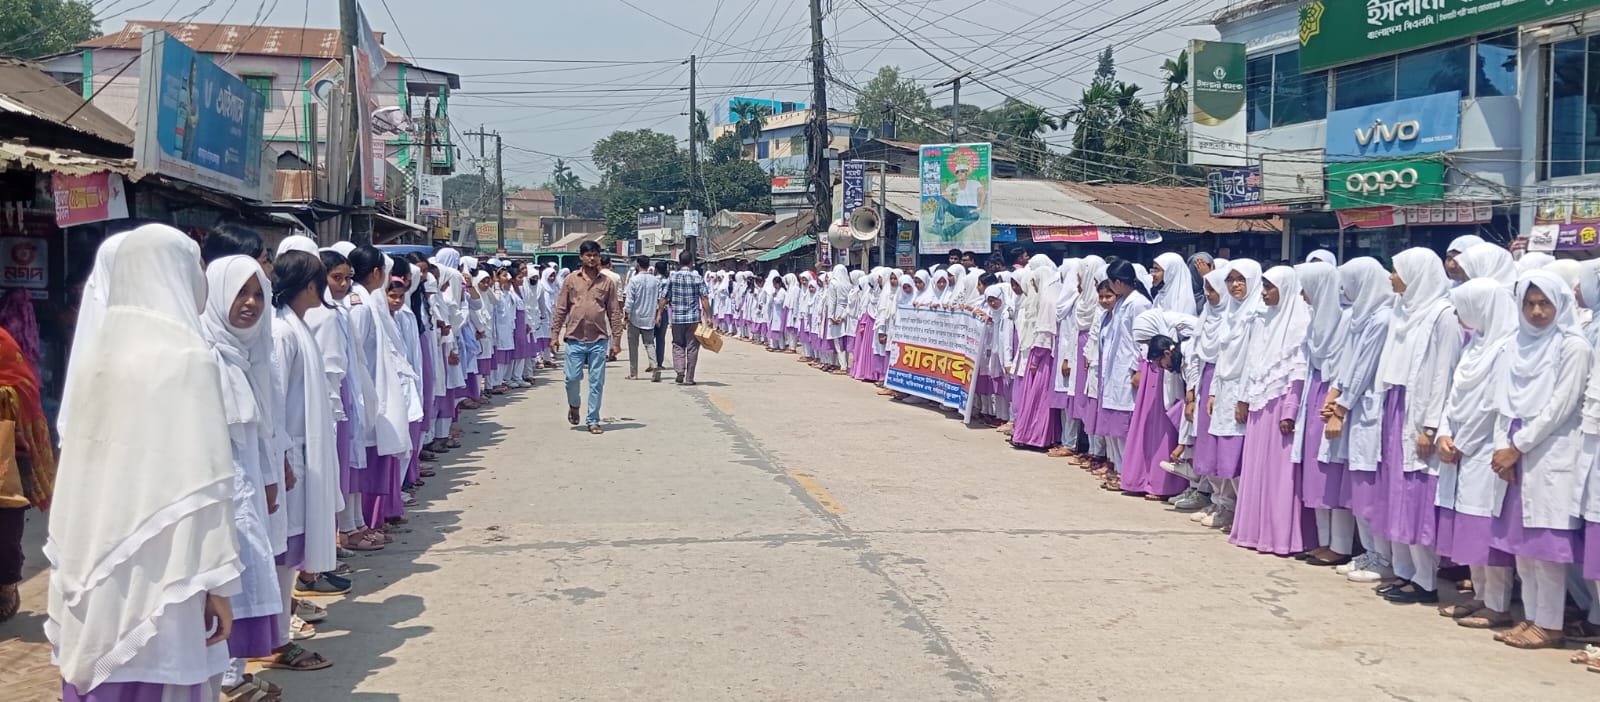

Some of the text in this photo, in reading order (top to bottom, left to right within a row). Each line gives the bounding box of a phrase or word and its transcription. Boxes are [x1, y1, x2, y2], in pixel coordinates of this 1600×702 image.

[1355, 118, 1420, 145] vivo
[1346, 168, 1418, 196] oppo
[4, 266, 43, 280] নগদ
